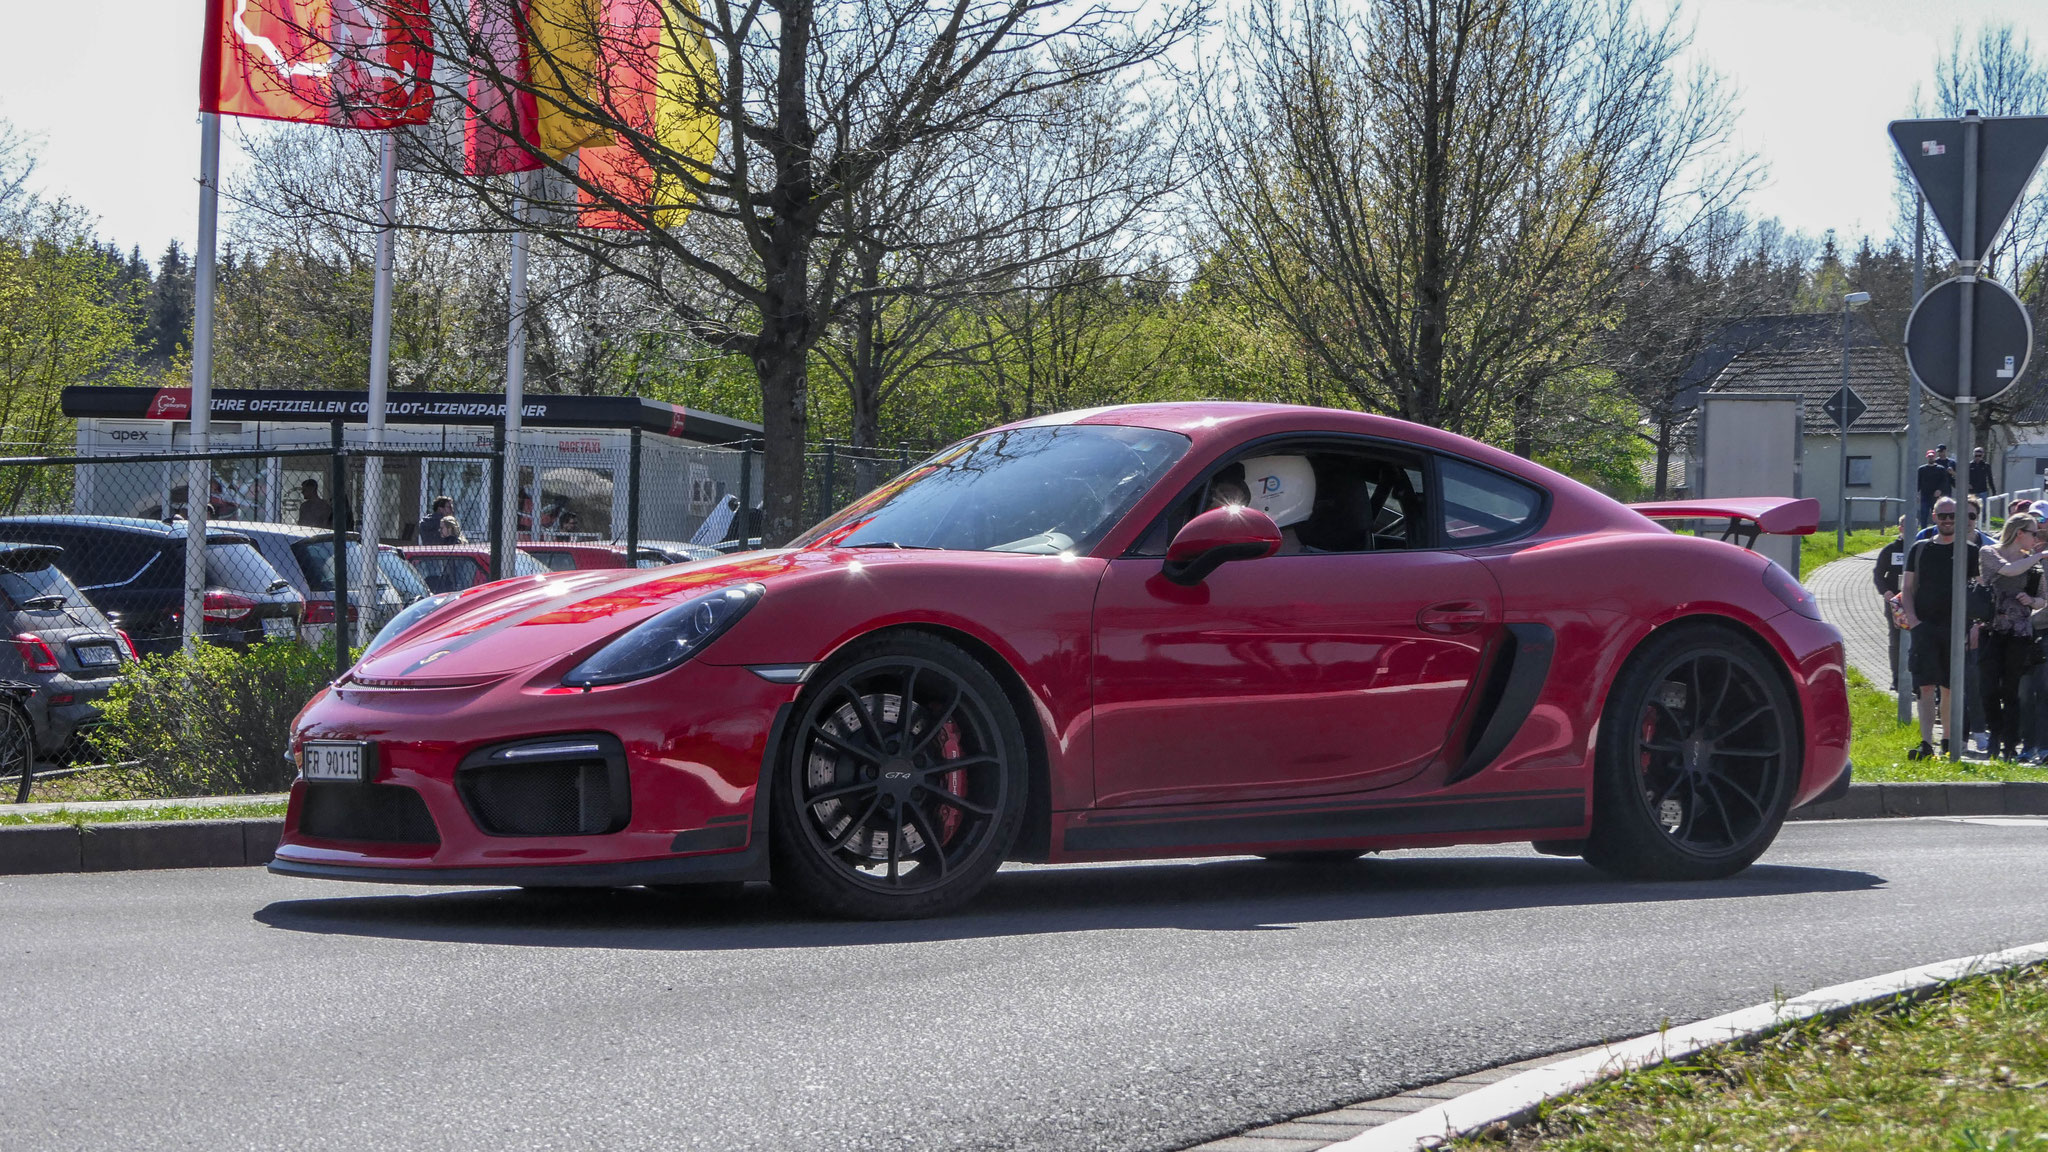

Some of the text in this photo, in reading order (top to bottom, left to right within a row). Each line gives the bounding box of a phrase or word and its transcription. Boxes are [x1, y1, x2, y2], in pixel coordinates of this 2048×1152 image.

[210, 399, 246, 411] IHRE
[249, 400, 346, 413] OFFIZIELLEN
[111, 430, 149, 443] apex
[307, 750, 358, 775] FR 90115
[885, 771, 911, 779] GT4
